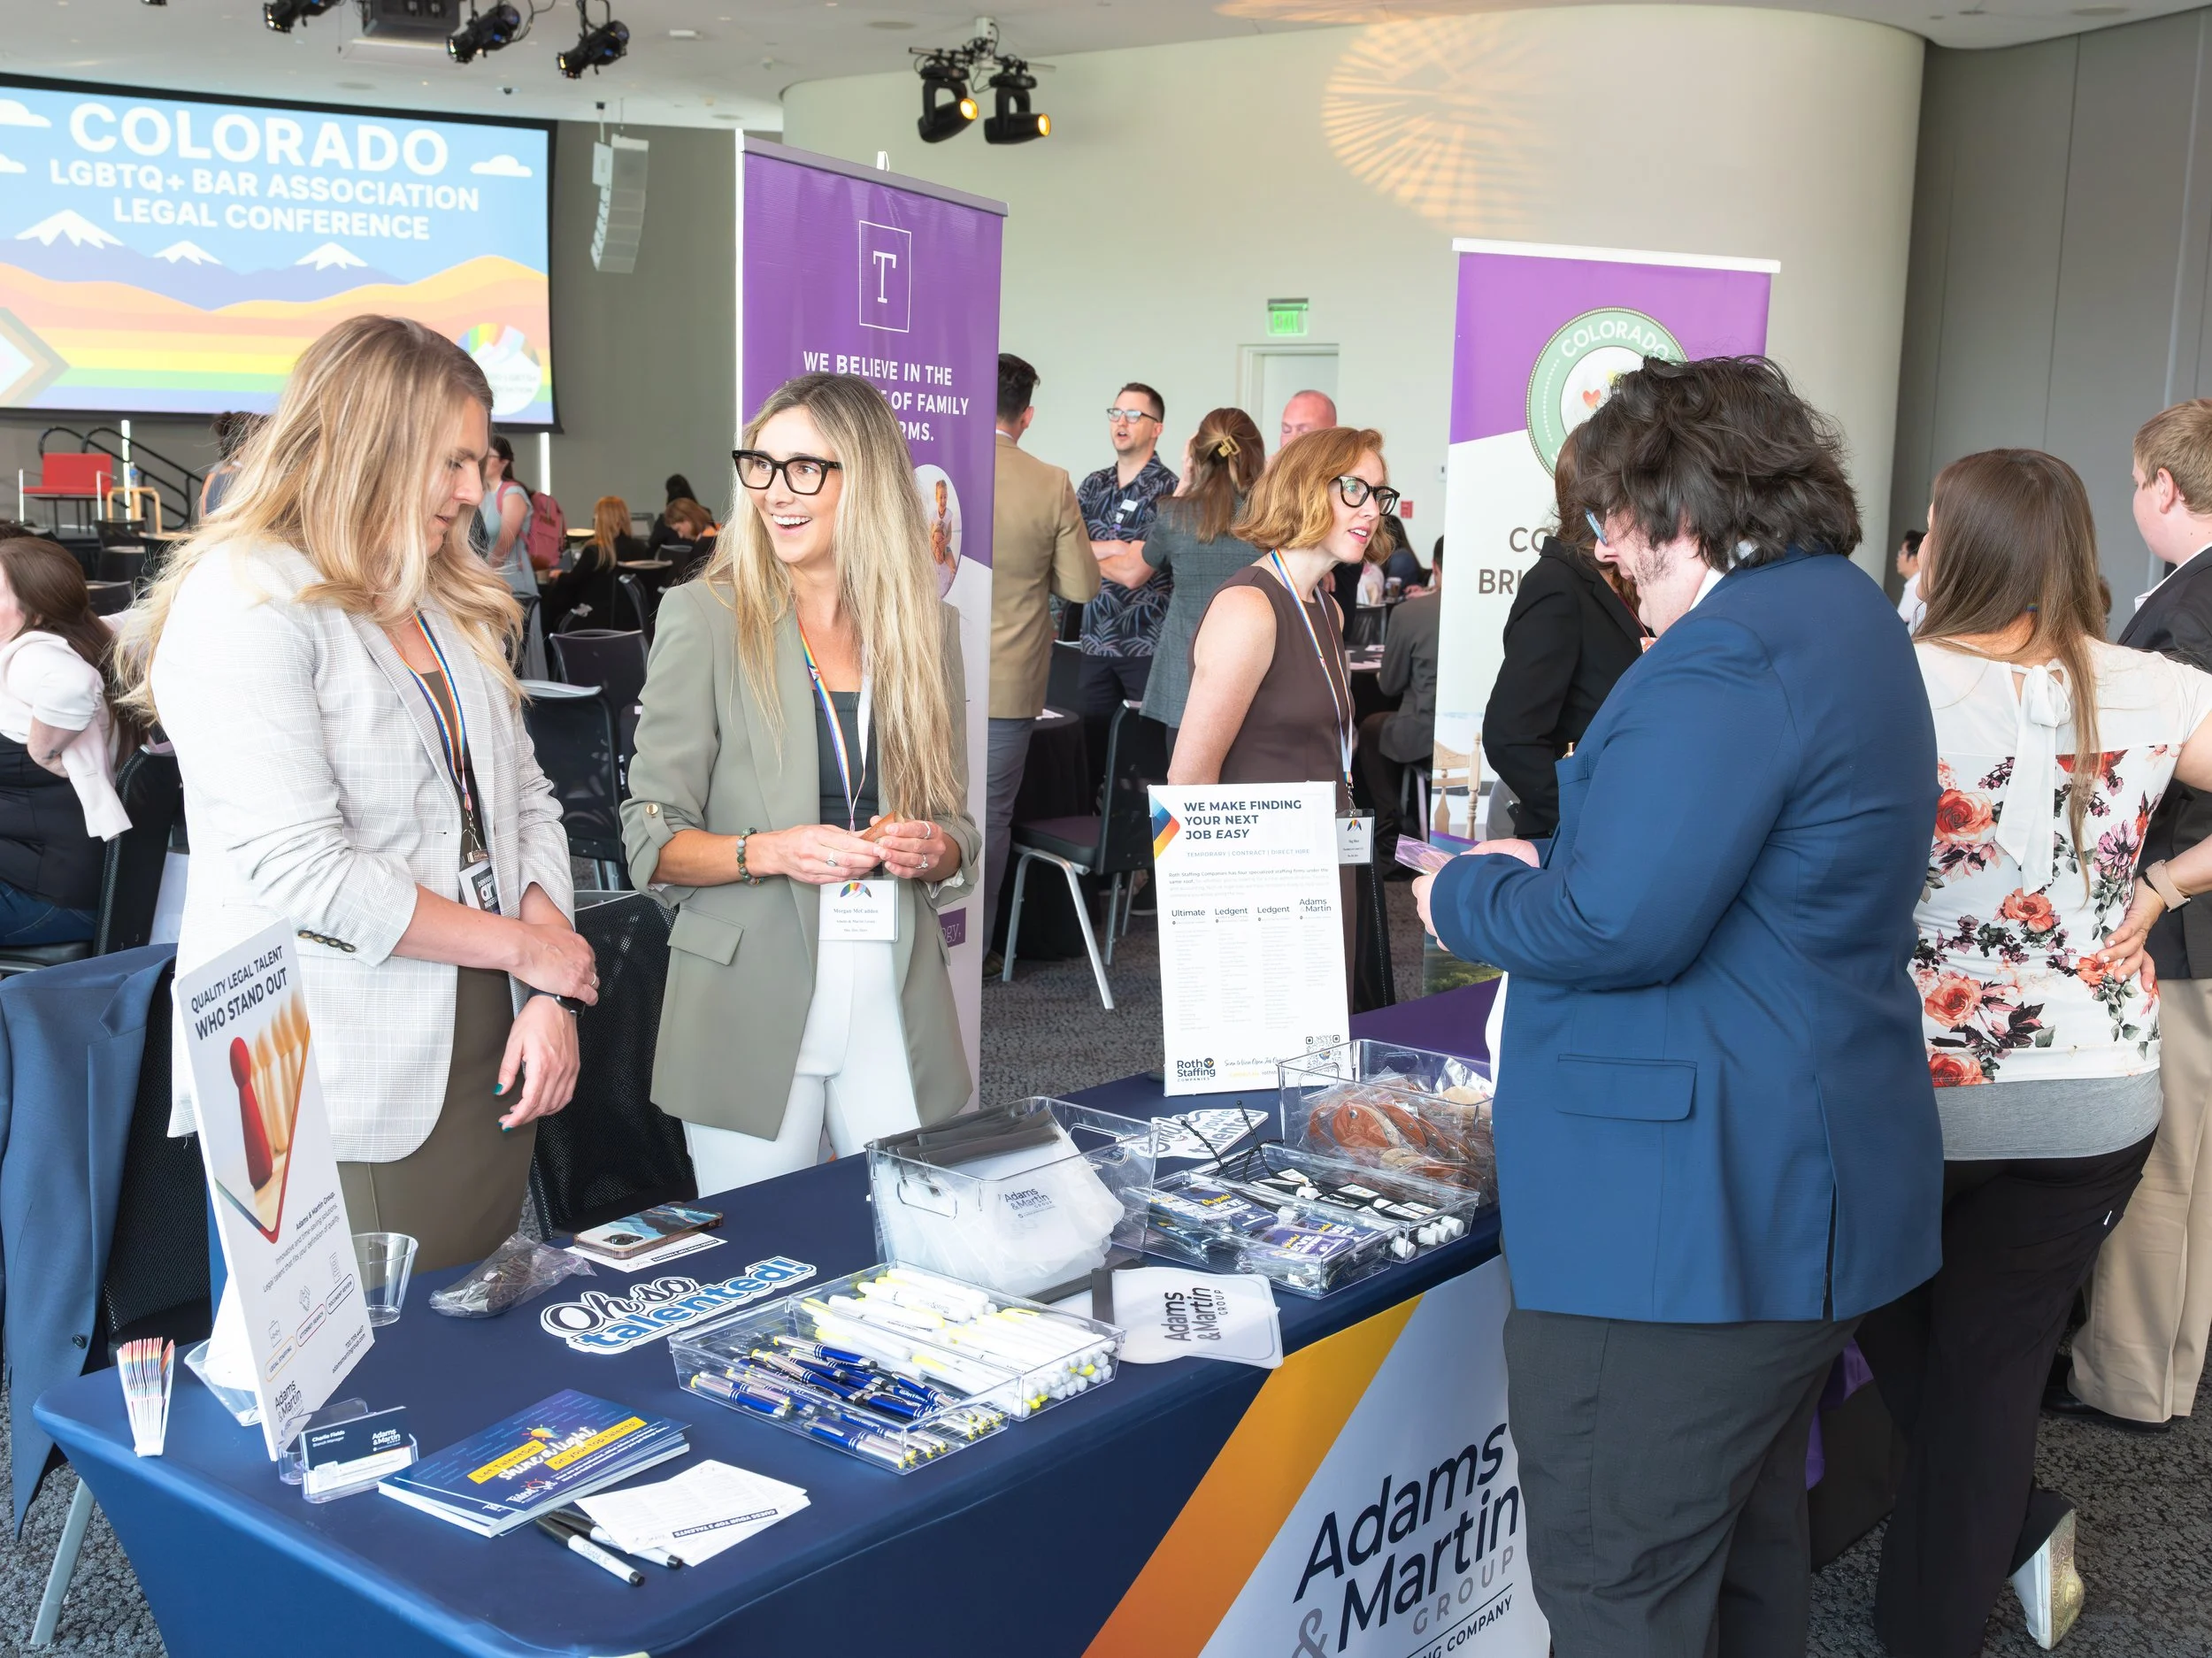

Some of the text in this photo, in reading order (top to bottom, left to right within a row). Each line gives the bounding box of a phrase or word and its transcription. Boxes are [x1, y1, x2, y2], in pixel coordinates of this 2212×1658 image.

[70, 102, 449, 176] COLORADO
[50, 159, 479, 211] LGBTQ+ BAR ASSOCIATION
[113, 197, 430, 240] LEGAL CONFERENCE
[872, 250, 897, 304] T
[1561, 319, 1671, 358] COLORADO
[803, 351, 952, 386] WE BELIEVE IN THE
[891, 391, 912, 411] OF
[918, 394, 969, 415] FAMILY
[1184, 800, 1302, 812] WE MAKE FINDING
[1185, 815, 1258, 826] YOUR NEXT
[1186, 828, 1249, 841] JOB EASY
[1171, 909, 1206, 917] Ultimate
[1215, 907, 1248, 917] Ledgent
[1257, 905, 1290, 915] Ledgent
[191, 945, 282, 1014] QUALITY LEGAL TALENT
[195, 966, 287, 1040] WHO STAND OUT
[1177, 1059, 1202, 1069] Roth
[1177, 1067, 1216, 1078] Staffing
[1004, 1187, 1039, 1202] Adams
[549, 1280, 694, 1329] Oh so
[580, 1260, 810, 1347] talented!
[1161, 1292, 1191, 1341] Adams
[1214, 1289, 1228, 1315] GROUP
[274, 1380, 296, 1408] Adams
[372, 1429, 396, 1439] Adams
[498, 1455, 543, 1480] shine
[549, 1425, 597, 1451] light
[714, 1519, 730, 1528] TOP
[730, 1514, 751, 1524] YOUR
[750, 1508, 776, 1520] GUESS
[1293, 1423, 1508, 1604] Adams
[674, 1525, 708, 1538] TALENTS
[1412, 1545, 1514, 1635] GROUP
[1448, 1594, 1513, 1653] COMPANY
